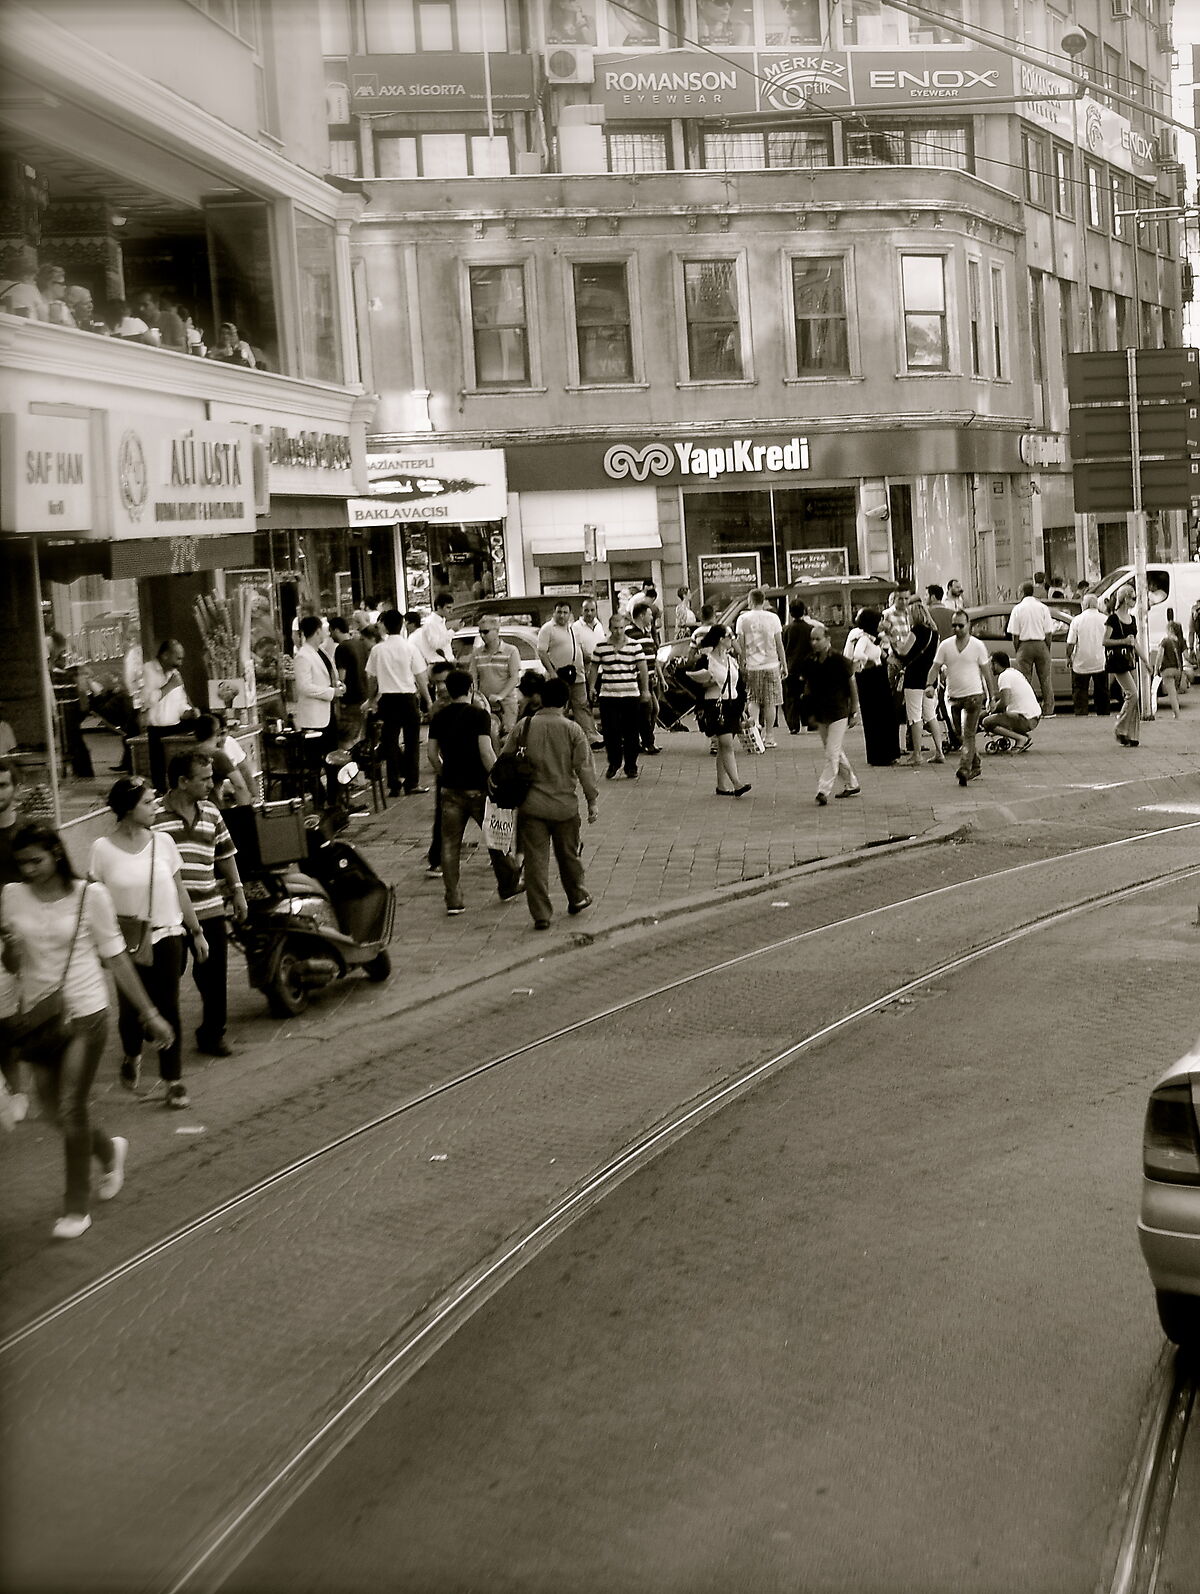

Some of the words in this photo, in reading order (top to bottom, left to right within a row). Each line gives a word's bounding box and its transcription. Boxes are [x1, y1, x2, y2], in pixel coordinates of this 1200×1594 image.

[763, 56, 847, 80] MERKEZ
[605, 71, 737, 91] ROMANSON
[869, 70, 998, 88] ENOX
[378, 86, 406, 96] AXA
[409, 84, 466, 96] SİGORTA
[623, 94, 722, 104] EYEWEAR
[910, 89, 960, 98] EYEWEAR
[201, 440, 242, 485] USTA
[674, 438, 809, 479] YapıKredi
[355, 506, 448, 521] BAKLAVACISI
